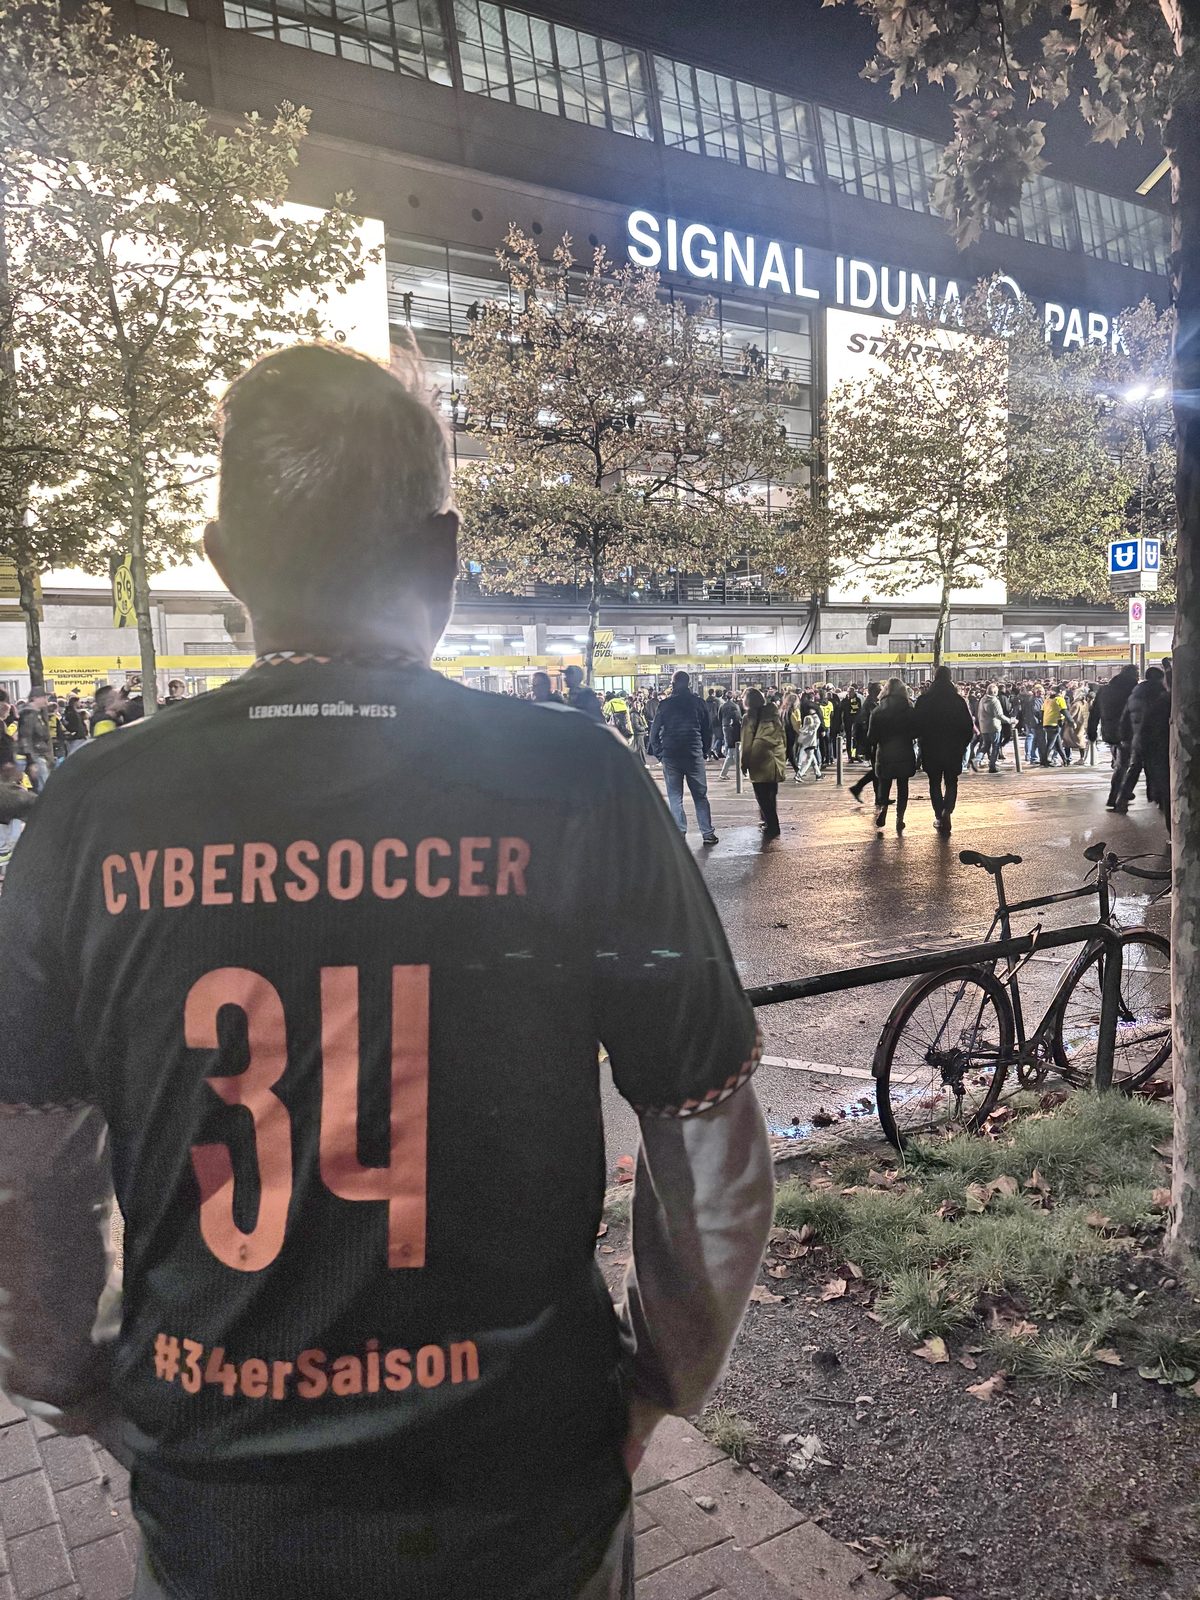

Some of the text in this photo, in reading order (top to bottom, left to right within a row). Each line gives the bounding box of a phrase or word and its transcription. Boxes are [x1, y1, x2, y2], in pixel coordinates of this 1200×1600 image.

[627, 209, 1130, 356] SIGNAL IDUNA PARK
[248, 700, 398, 719] LEBENSLANG GRÜN-WEISS
[101, 836, 532, 916] CYBERSOCCER
[184, 963, 431, 1273] 34
[153, 1332, 480, 1401] #34erSaison
